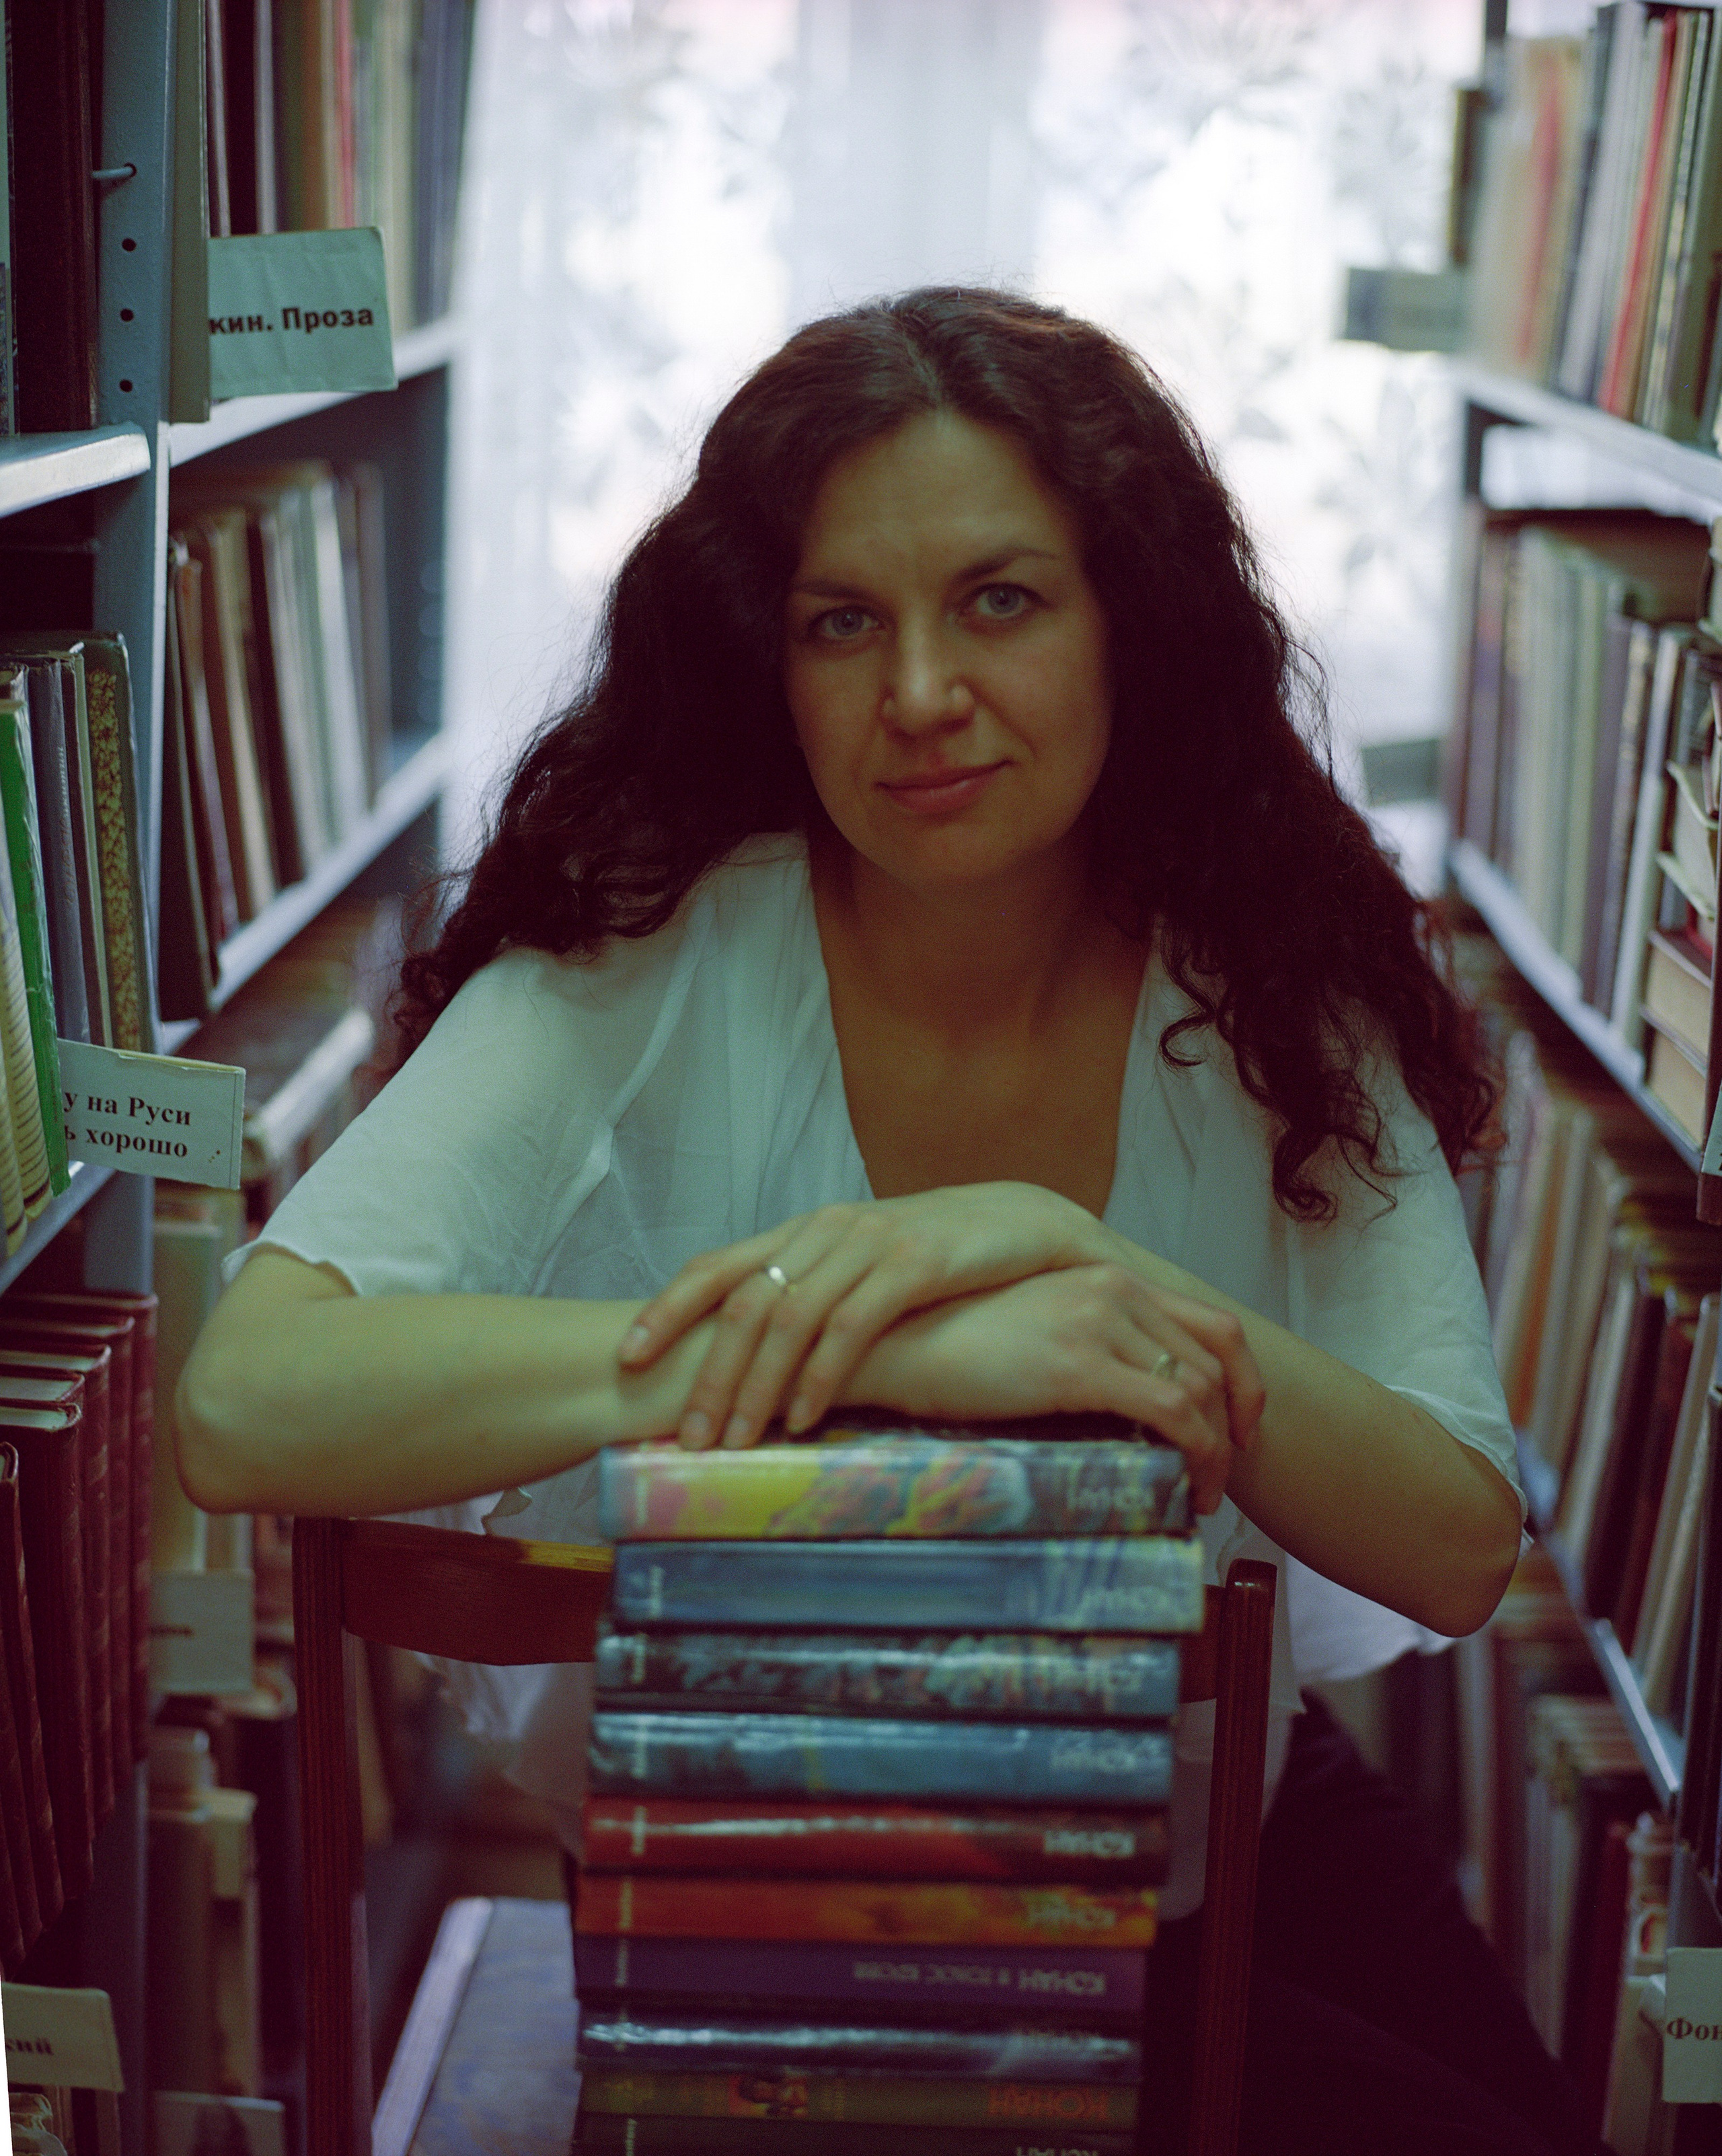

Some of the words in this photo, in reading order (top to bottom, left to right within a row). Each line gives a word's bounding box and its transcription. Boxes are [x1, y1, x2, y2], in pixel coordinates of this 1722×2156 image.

[282, 306, 374, 334] Проза
[87, 1095, 119, 1115] на
[128, 1096, 192, 1126] Руси
[85, 1128, 189, 1158] хорошо
[1018, 1970, 1107, 1995] КОНАН
[987, 2084, 1109, 2122] КОНАН
